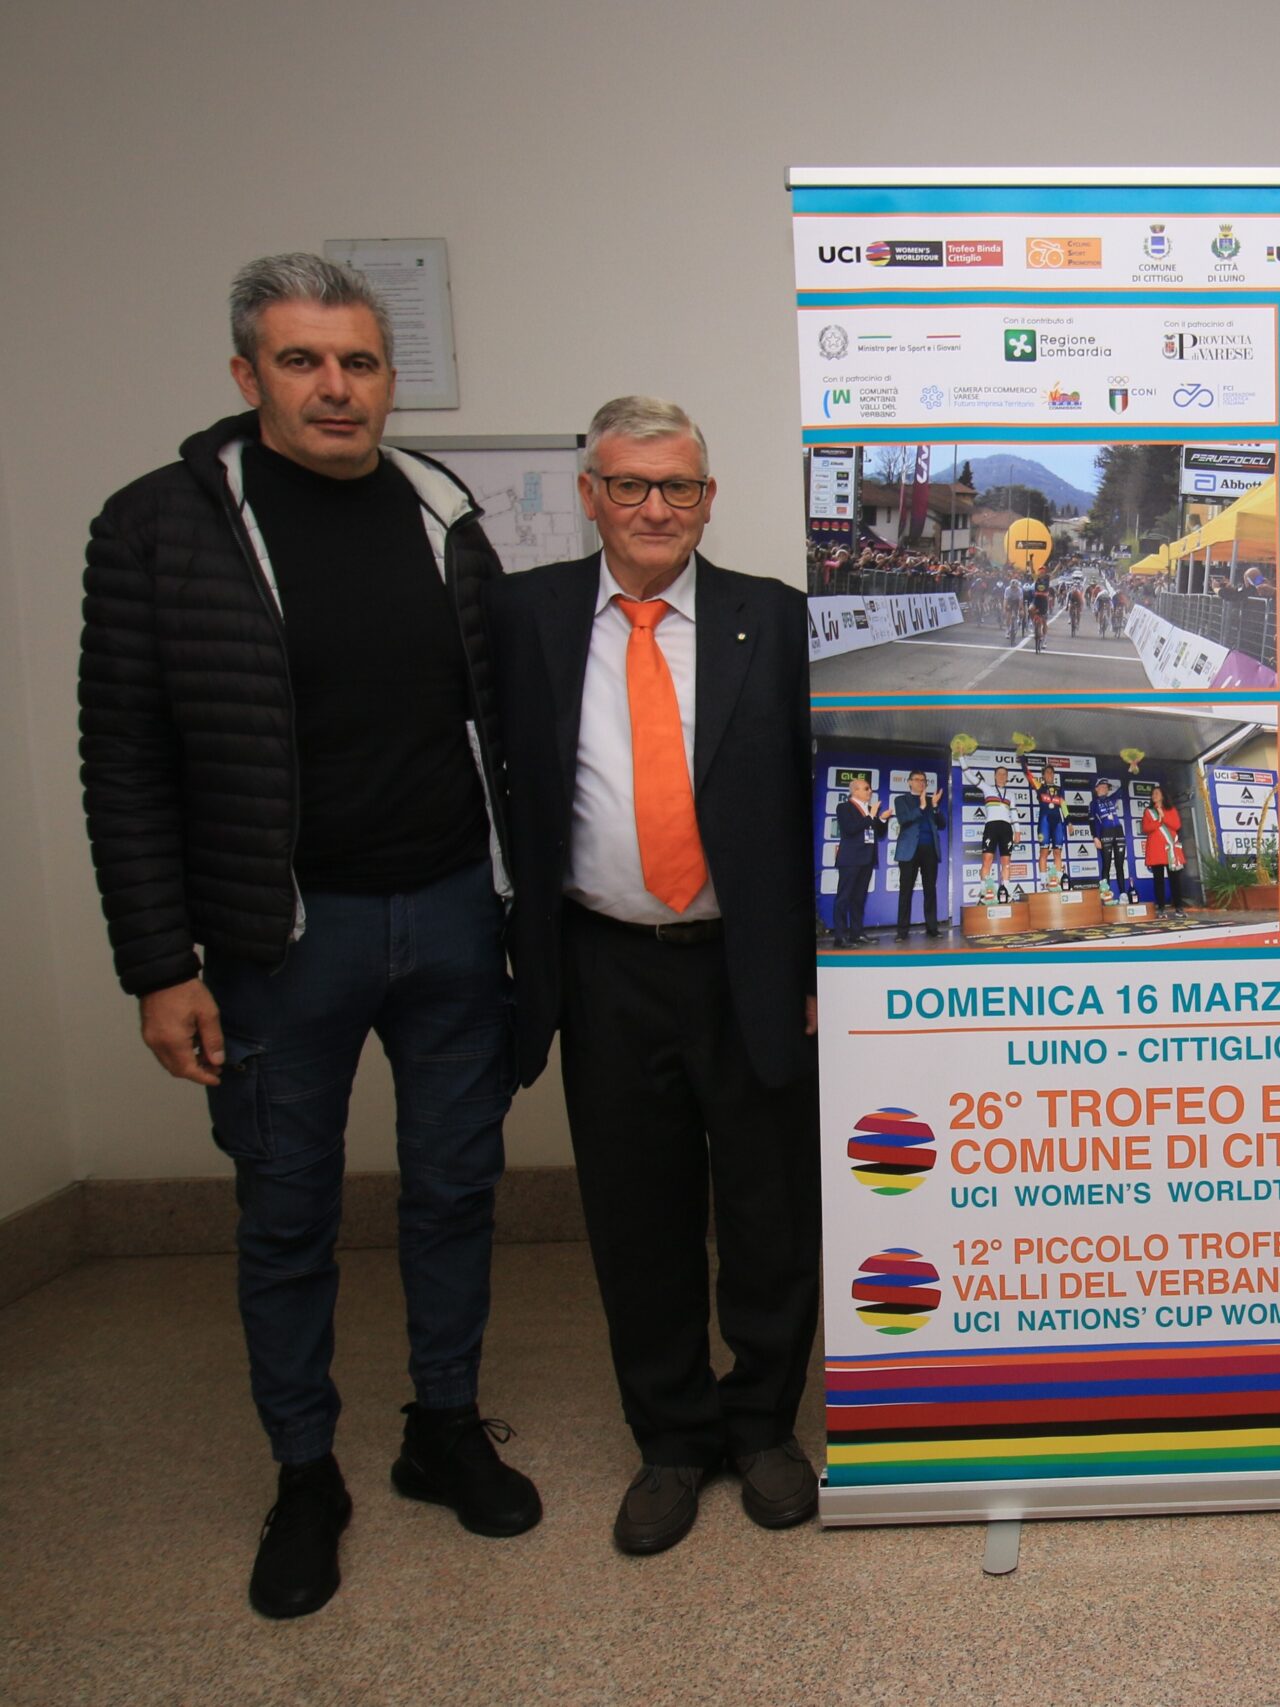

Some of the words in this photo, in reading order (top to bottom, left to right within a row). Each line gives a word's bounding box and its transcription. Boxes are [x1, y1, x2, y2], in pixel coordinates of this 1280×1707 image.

[819, 246, 861, 263] UCI
[947, 244, 974, 253] Trofeo
[977, 244, 1001, 253] Binda
[947, 254, 982, 263] Cittiglio
[1138, 264, 1177, 272] COMUNE
[1214, 263, 1238, 272] CITTÀ
[1003, 317, 1019, 325] Con
[1028, 317, 1065, 325] contributo
[1067, 317, 1074, 325] di
[1187, 320, 1223, 329] patrocinio
[1225, 320, 1234, 328] di
[1039, 334, 1096, 348] Regione
[907, 345, 926, 353] Sport
[1039, 346, 1112, 358] Lombardia
[1199, 348, 1254, 361] VARESE
[993, 386, 1037, 394] COMMERCIO
[1131, 388, 1157, 396] CONI
[1190, 453, 1271, 465] PERUFFOCICLI
[995, 755, 1014, 764] UCI
[1215, 772, 1229, 780] UCI
[886, 984, 1104, 1020] DOMENICA
[1117, 984, 1158, 1016] 16
[1007, 1039, 1107, 1066] LUINO
[948, 1091, 1022, 1130] 26°
[1037, 1085, 1245, 1128] TROFEO
[950, 1135, 1151, 1175] COMUNE
[1166, 1133, 1210, 1169] DI
[950, 1186, 997, 1209] UCI
[1015, 1182, 1151, 1207] WOMEN’S
[953, 1239, 1003, 1266] 12°
[1013, 1233, 1169, 1265] PICCOLO
[952, 1274, 1048, 1302] VALLI
[1059, 1271, 1127, 1299] DEL
[953, 1312, 1000, 1334] UCI
[1018, 1306, 1147, 1331] NATIONS’
[1156, 1305, 1212, 1328] CUP
